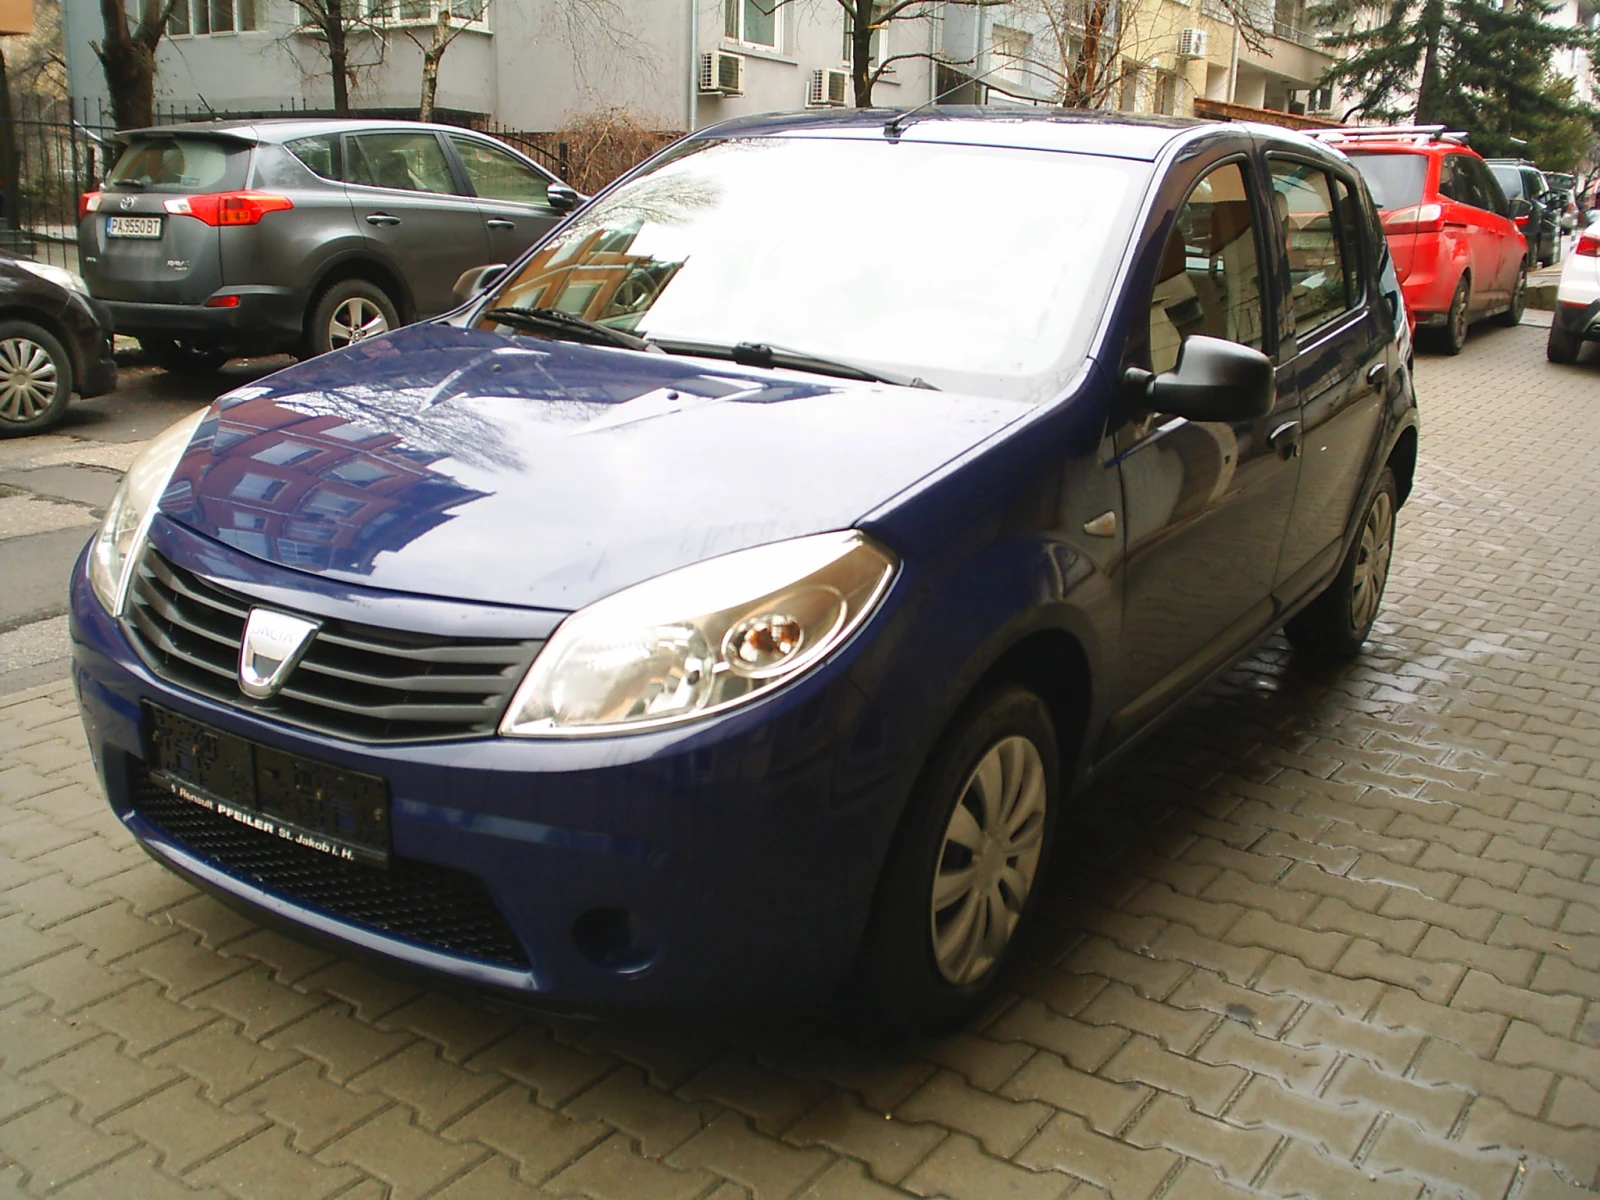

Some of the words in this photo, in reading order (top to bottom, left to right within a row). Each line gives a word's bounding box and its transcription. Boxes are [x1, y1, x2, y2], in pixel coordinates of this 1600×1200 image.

[112, 219, 123, 233] PA
[124, 219, 146, 233] 9550
[146, 219, 159, 235] BT
[251, 627, 292, 643] DACIA
[179, 787, 213, 810] Renault
[217, 803, 274, 833] PFEILER
[278, 827, 293, 841] St.
[295, 834, 330, 853] Jakob
[341, 847, 354, 861] H.
